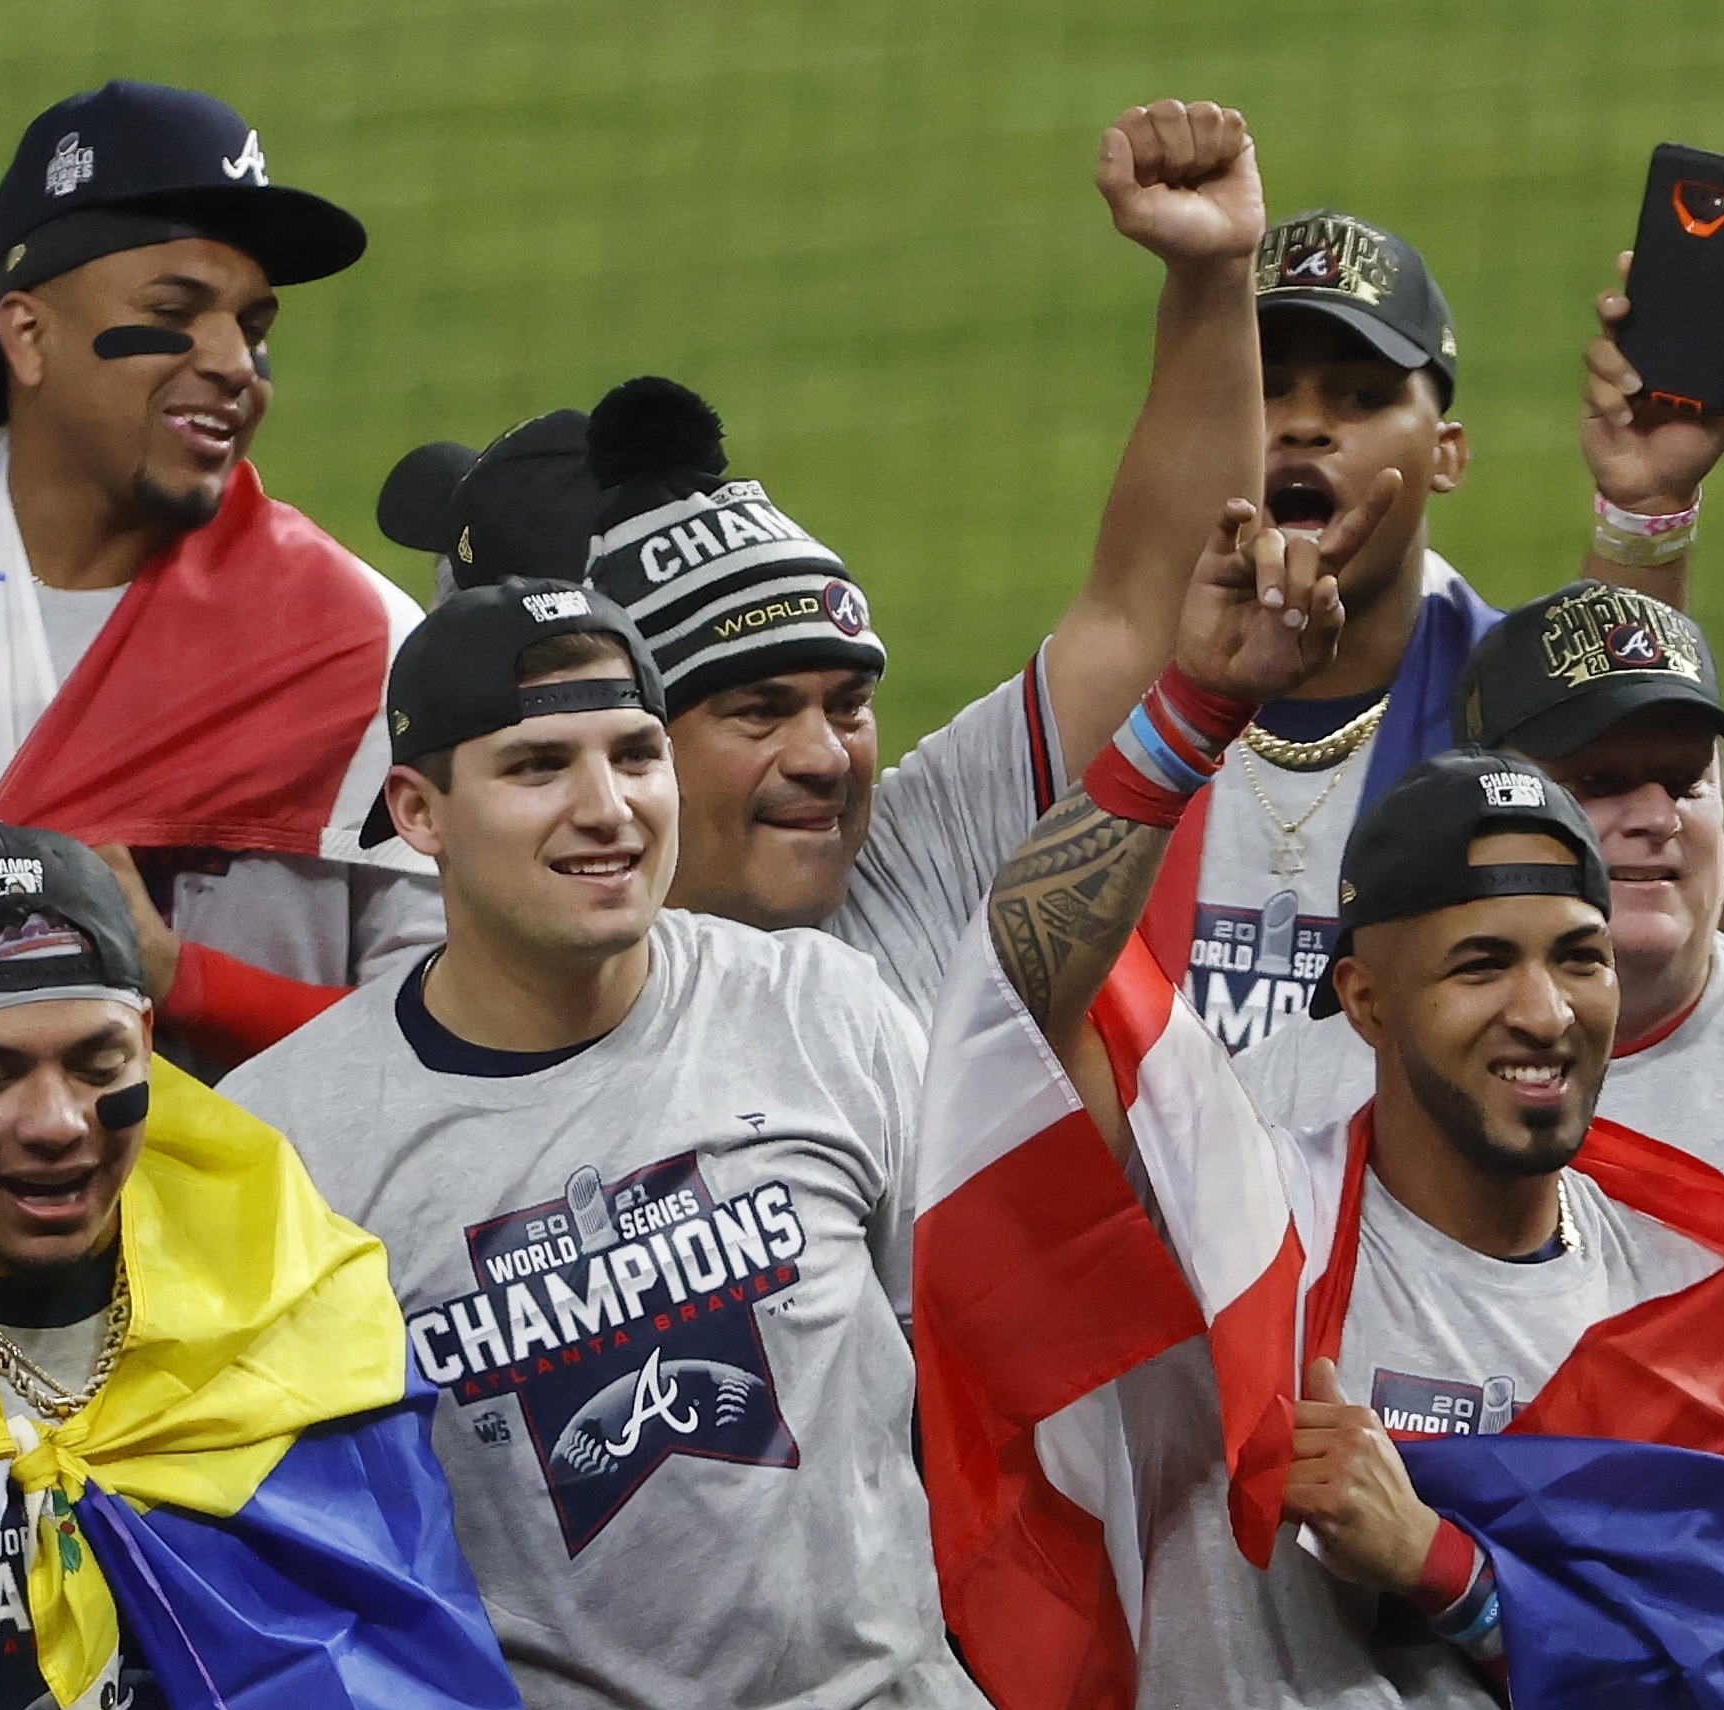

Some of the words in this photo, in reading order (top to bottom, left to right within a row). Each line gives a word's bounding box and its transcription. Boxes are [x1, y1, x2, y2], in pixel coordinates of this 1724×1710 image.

[222, 129, 269, 187] A
[713, 598, 819, 637] WORLD
[832, 591, 858, 625] A
[1615, 630, 1653, 657] A
[1479, 772, 1543, 791] CHAMPS
[1213, 919, 1257, 942] 20
[1297, 929, 1324, 951] 21
[526, 1215, 569, 1240] 20
[614, 1184, 650, 1210] 21
[486, 1235, 578, 1285] WORLD
[618, 1189, 701, 1240] SERIES
[408, 1184, 803, 1384] CHAMPIONS
[465, 1331, 631, 1396] ATLANTA
[654, 1265, 792, 1332] BRAVES
[606, 1347, 699, 1457] A
[1431, 1395, 1475, 1418] 20
